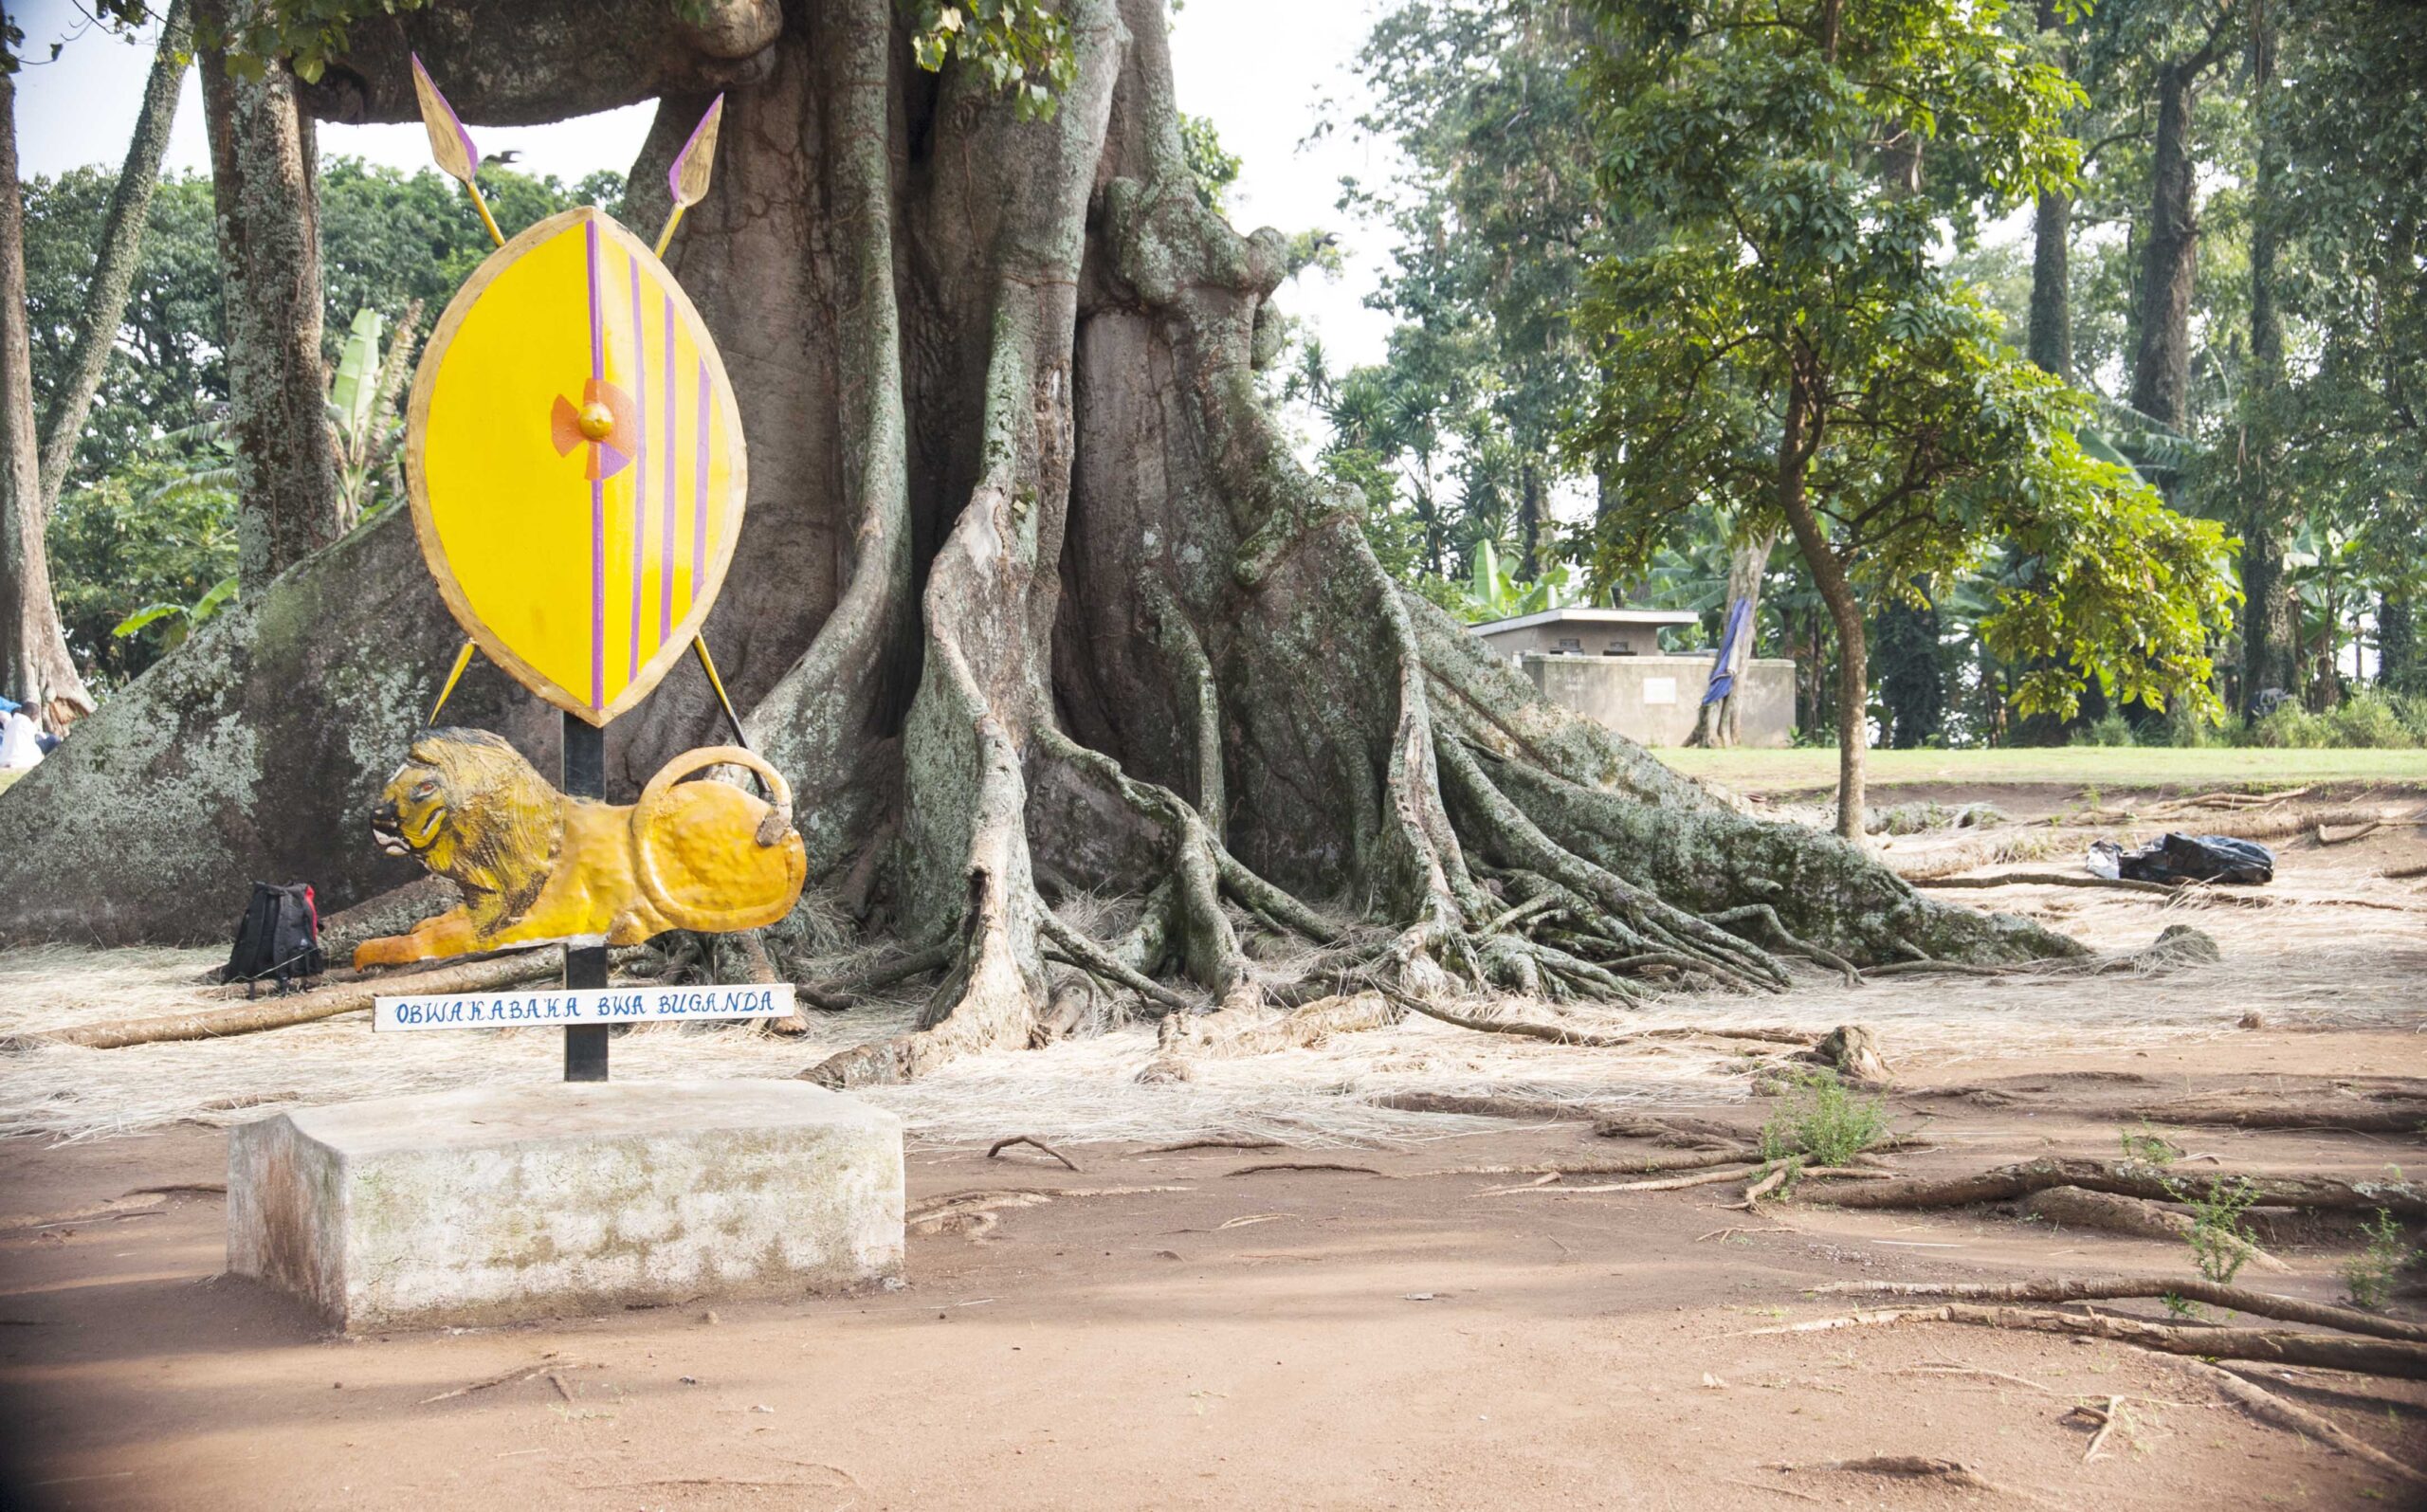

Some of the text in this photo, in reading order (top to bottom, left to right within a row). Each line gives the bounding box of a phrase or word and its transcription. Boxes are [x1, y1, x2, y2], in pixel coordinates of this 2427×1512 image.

[395, 991, 775, 1024] OBWAKABAKA BWA BUGANDA
